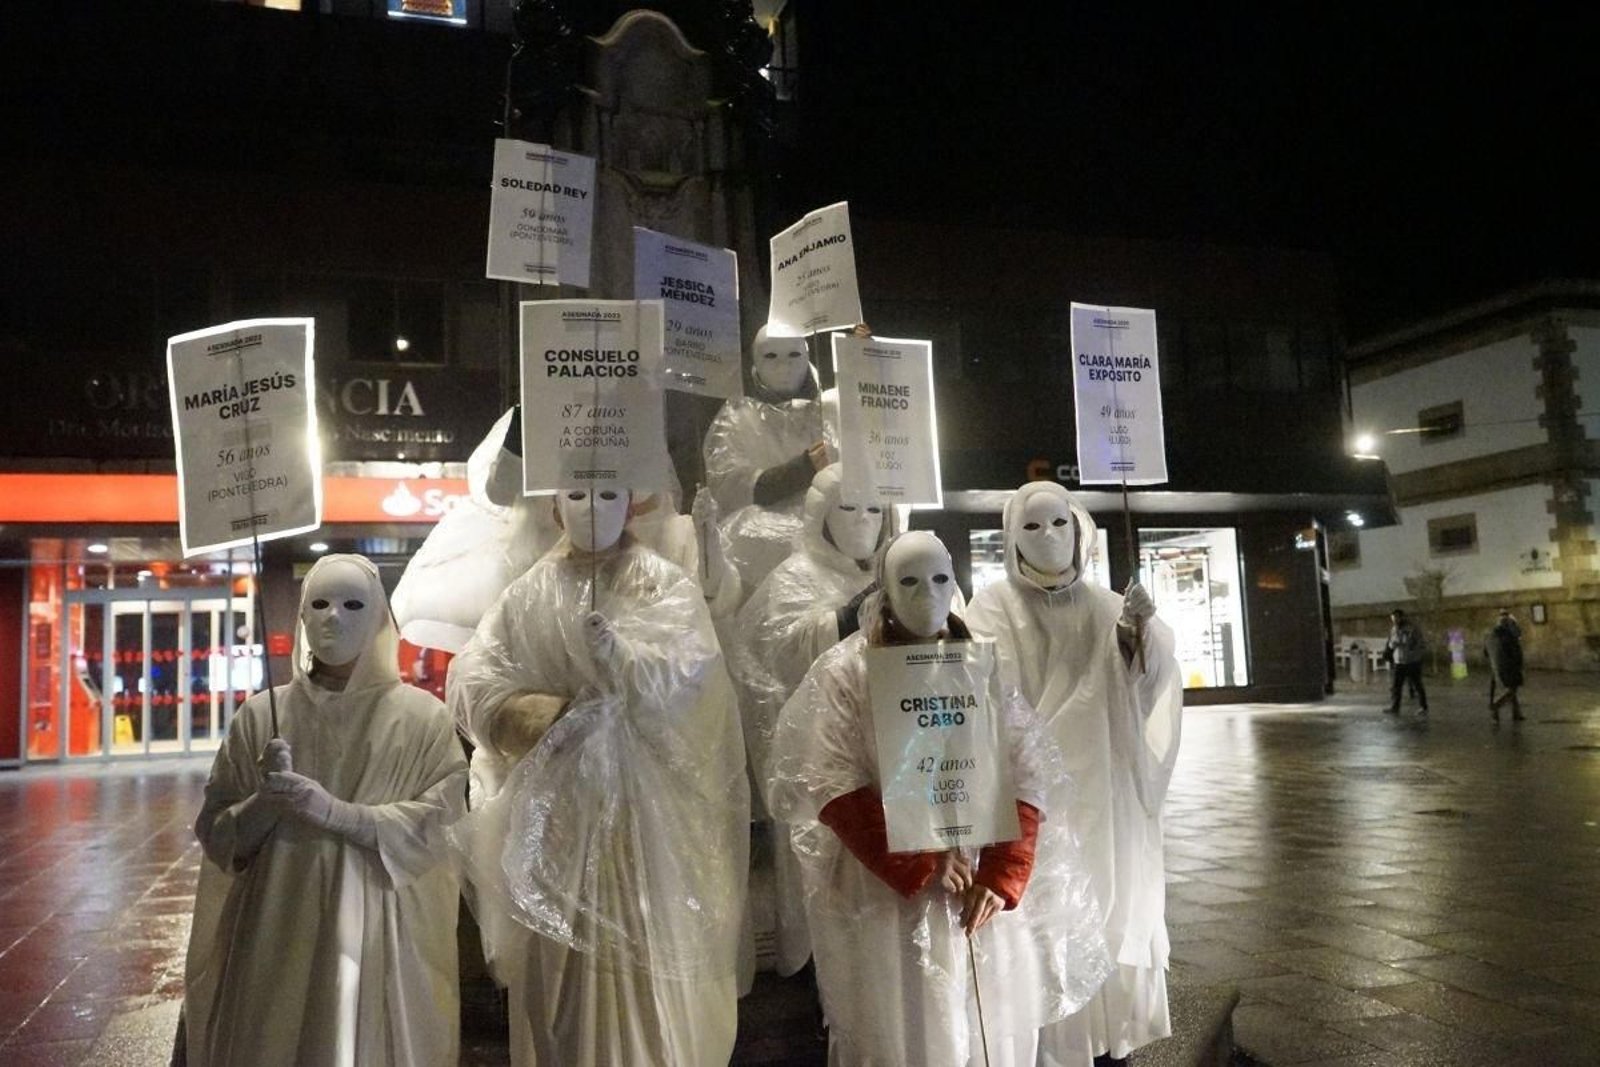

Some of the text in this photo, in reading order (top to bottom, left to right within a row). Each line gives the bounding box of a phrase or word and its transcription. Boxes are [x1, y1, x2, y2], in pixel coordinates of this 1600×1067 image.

[501, 178, 588, 199] SOLEDAD REY
[778, 234, 846, 271] ANA ENJAMIO
[661, 276, 715, 296] JESSICA
[666, 319, 713, 342] 29 anos
[544, 350, 640, 363] CONSUELO
[1079, 354, 1151, 370] CLARA MARÍA
[547, 364, 638, 378] PALACIOS
[185, 371, 296, 411] MARÍA JESÚS
[858, 382, 910, 397] MINAENE
[219, 397, 261, 420] CRUZ
[861, 395, 909, 410] FRANCO
[562, 403, 627, 418] 87 anos
[1114, 408, 1137, 420] anos
[563, 424, 625, 436] A CORUÑA
[559, 436, 630, 449] (A CORUÑA)
[884, 436, 911, 447] anos
[216, 443, 272, 468] 56 anos
[900, 694, 978, 713] CRISTINA
[917, 711, 966, 728] CABO
[916, 756, 977, 773] 42 anos
[932, 779, 965, 792] LUGO
[930, 791, 970, 806] (LUGO)
